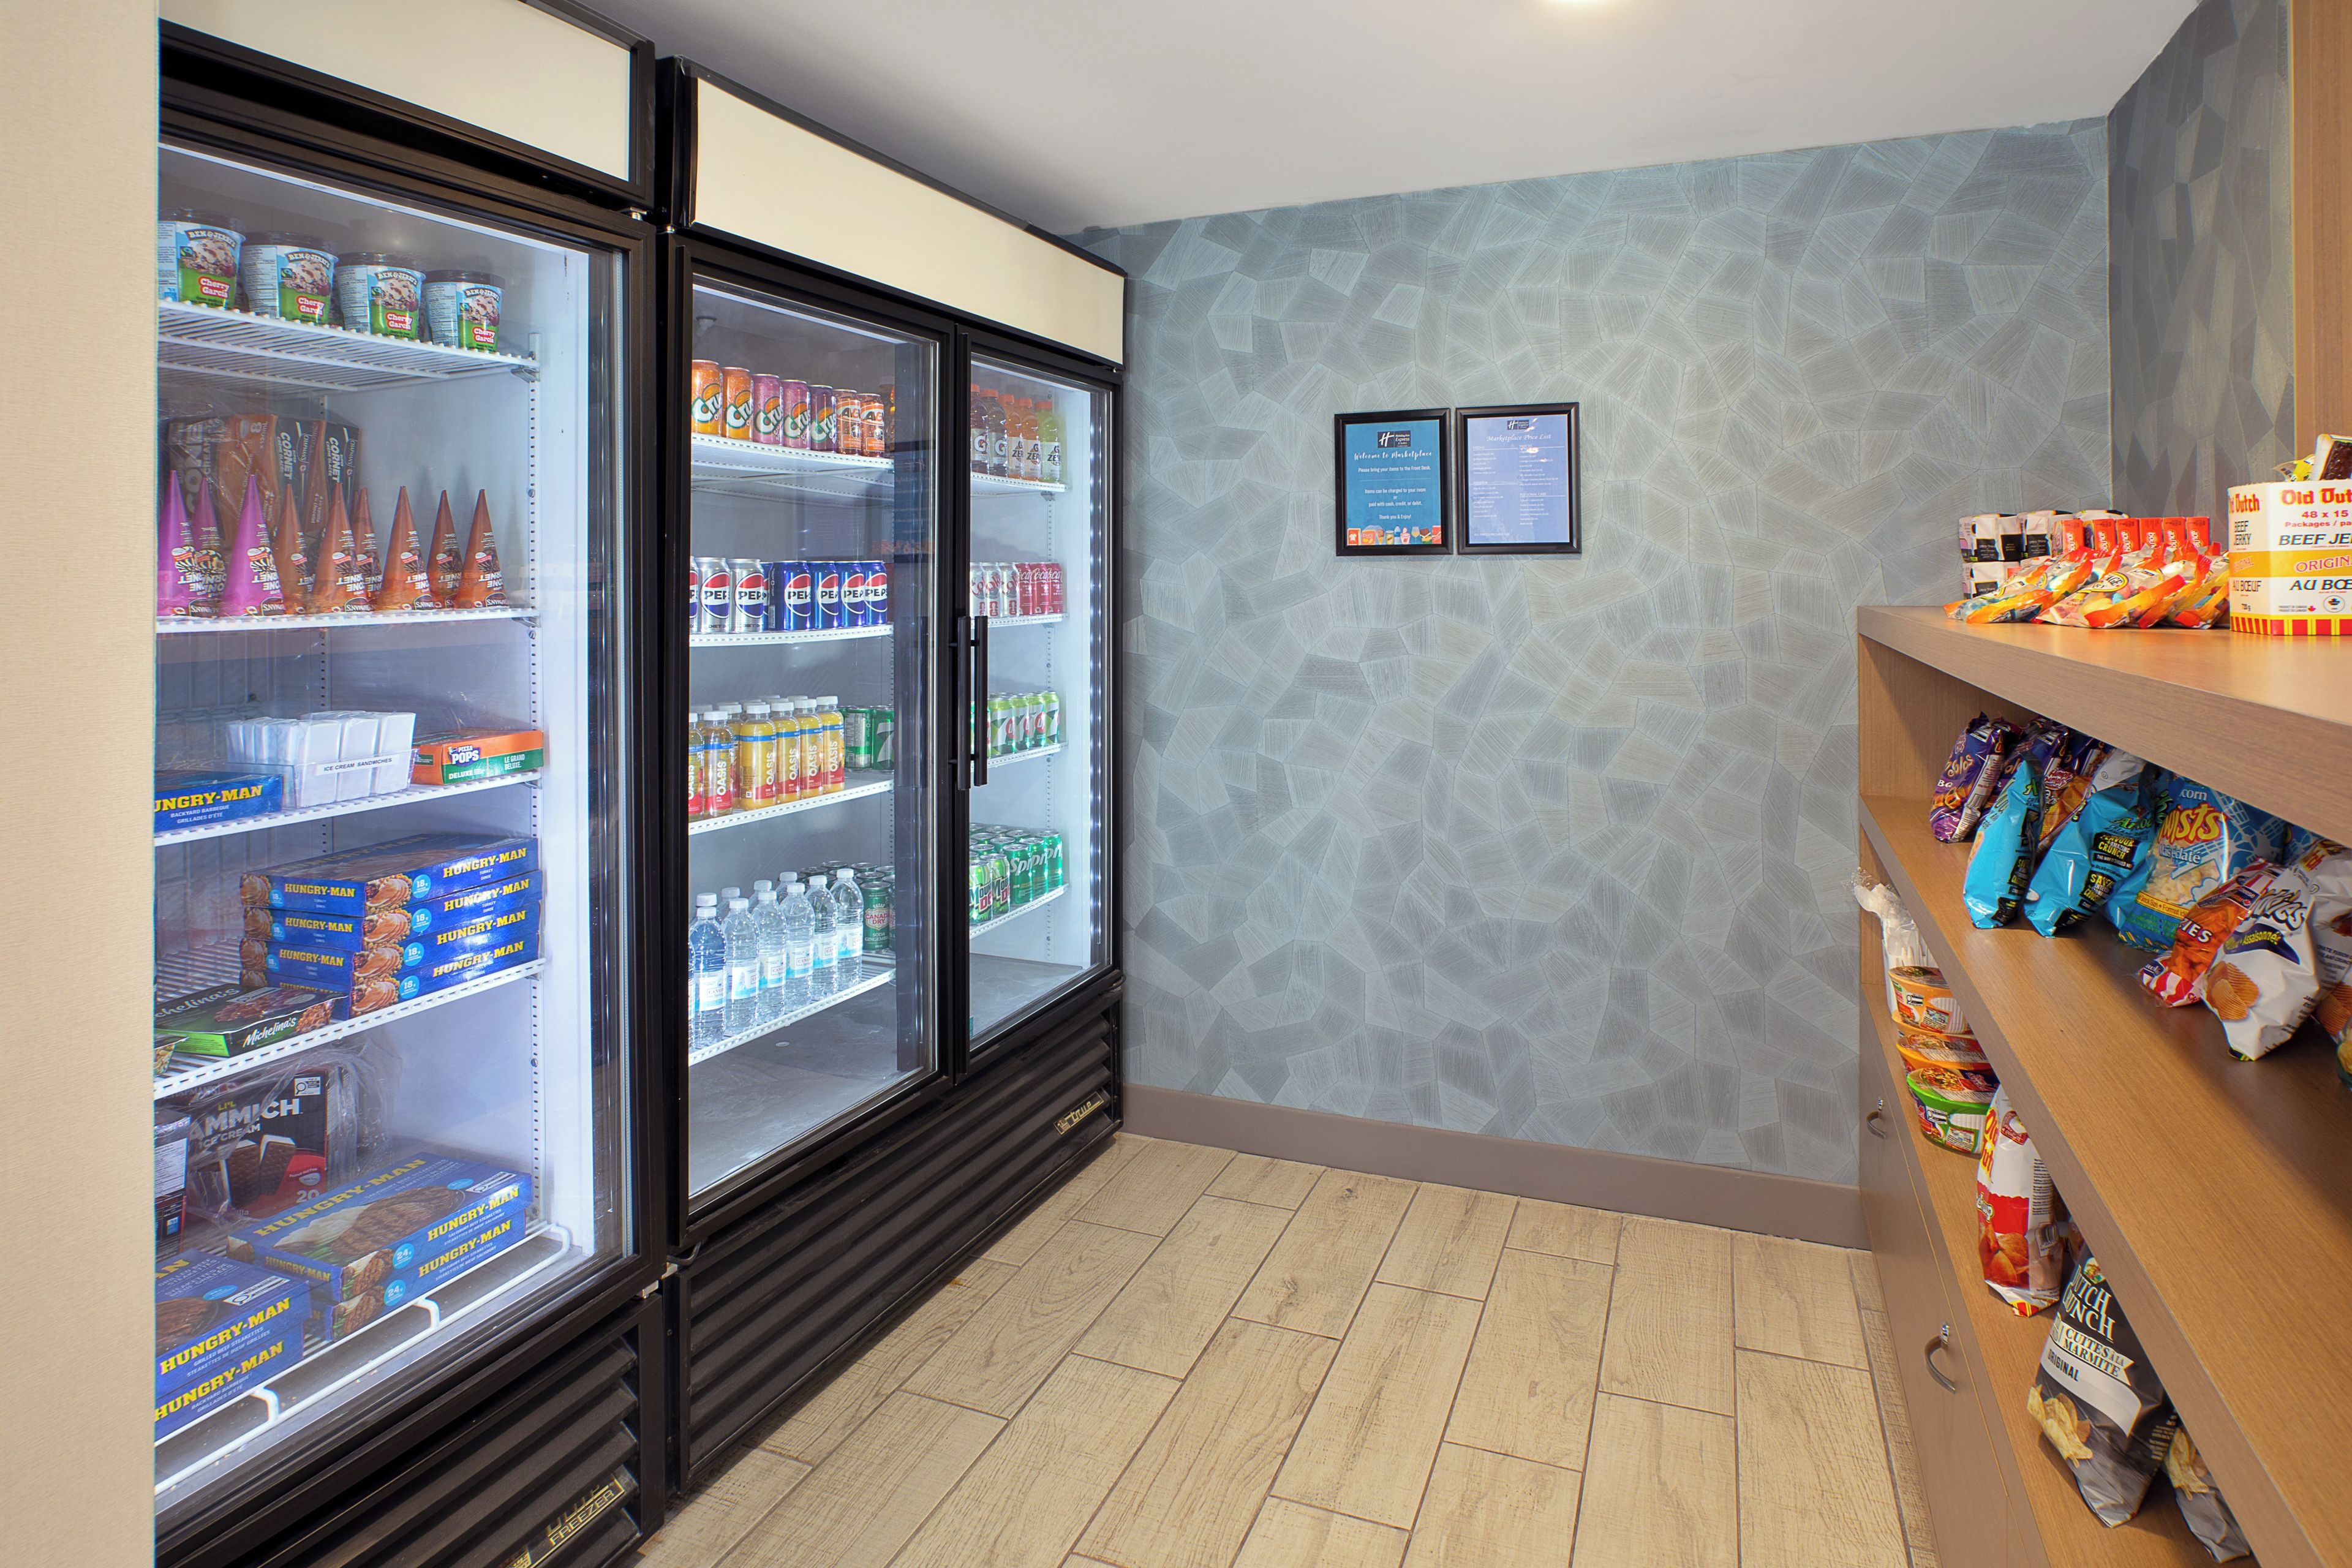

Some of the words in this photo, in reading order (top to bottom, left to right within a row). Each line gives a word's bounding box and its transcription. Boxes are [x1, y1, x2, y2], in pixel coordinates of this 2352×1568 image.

[200, 278, 230, 291] Cherry
[203, 287, 228, 298] Garcia
[298, 297, 324, 309] Cherry
[388, 314, 412, 324] Cherry
[692, 393, 722, 424] Cru
[726, 394, 752, 427] Cru
[280, 432, 294, 480] CORNET
[330, 437, 341, 483] CORNET
[1354, 451, 1381, 461] Welcome
[1391, 450, 1432, 461] Marketplace
[2235, 494, 2260, 513] Dutch
[2280, 489, 2314, 505] Old
[2321, 488, 2352, 505] Dut
[2234, 521, 2248, 533] BEEF
[2121, 530, 2132, 552] bounce
[2234, 533, 2252, 545] JERKY
[2278, 534, 2327, 546] BEEF
[844, 589, 864, 598] PEP
[2233, 580, 2240, 591] AU
[2290, 579, 2317, 590] AU
[2321, 578, 2352, 590] BŒ
[738, 590, 763, 600] PEP
[451, 749, 480, 764] POPS
[458, 745, 473, 754] PIZZA
[356, 757, 393, 768] SANDWICHES
[809, 745, 818, 777] OASIS
[448, 771, 473, 780] DELUXE
[717, 761, 727, 796] OASIS
[155, 784, 263, 812] UNGRY-MAN
[170, 809, 201, 819] BACKYARD
[201, 804, 230, 815] BARBEQUE
[176, 814, 208, 824] GRILLADES
[2098, 842, 2126, 859] CRUNCH
[2172, 846, 2201, 864] éclaté
[443, 848, 527, 878] HUNGRY-MAN
[284, 883, 355, 897] HUNGRY-MAN
[444, 879, 530, 911] HUNGRY-MAN
[2162, 905, 2179, 914] Format
[285, 917, 353, 932] HUNGRY-MAN
[437, 910, 526, 944] HUNGRY-MAN
[2178, 917, 2212, 943] ZIES
[279, 949, 344, 967] HUNGRY-MAN
[432, 941, 524, 978] HUNGRY-MAN
[243, 1017, 296, 1048] Michelina's
[190, 1098, 301, 1141] AMMICH
[217, 1123, 261, 1143] CREAM
[254, 1159, 428, 1236] HUNGRY-MAN
[296, 1189, 320, 1204] 20
[428, 1186, 519, 1242] HUNGRY-MAN
[469, 1221, 480, 1229] BEEF
[418, 1219, 512, 1278] HUNGRY-MAN
[266, 1256, 331, 1282] HUNGRY-MAN
[2071, 1264, 2113, 1313] DUTCH
[2062, 1281, 2116, 1340] CRUNCH
[160, 1297, 291, 1375] HUNGRY-MAN
[194, 1352, 216, 1366] GRILLED
[217, 1344, 230, 1355] BEEF
[230, 1326, 264, 1348] STEAKETTES
[2062, 1338, 2121, 1377] MARMITE
[2065, 1328, 2110, 1358] CUITES
[2116, 1354, 2125, 1366] LA
[186, 1356, 222, 1377] STEAKETTES
[2048, 1349, 2081, 1382] ORIGINAL
[155, 1340, 284, 1422] HUNGRY-MAN
[191, 1389, 221, 1410] BACKYARD
[549, 1489, 614, 1545] FREEZER
